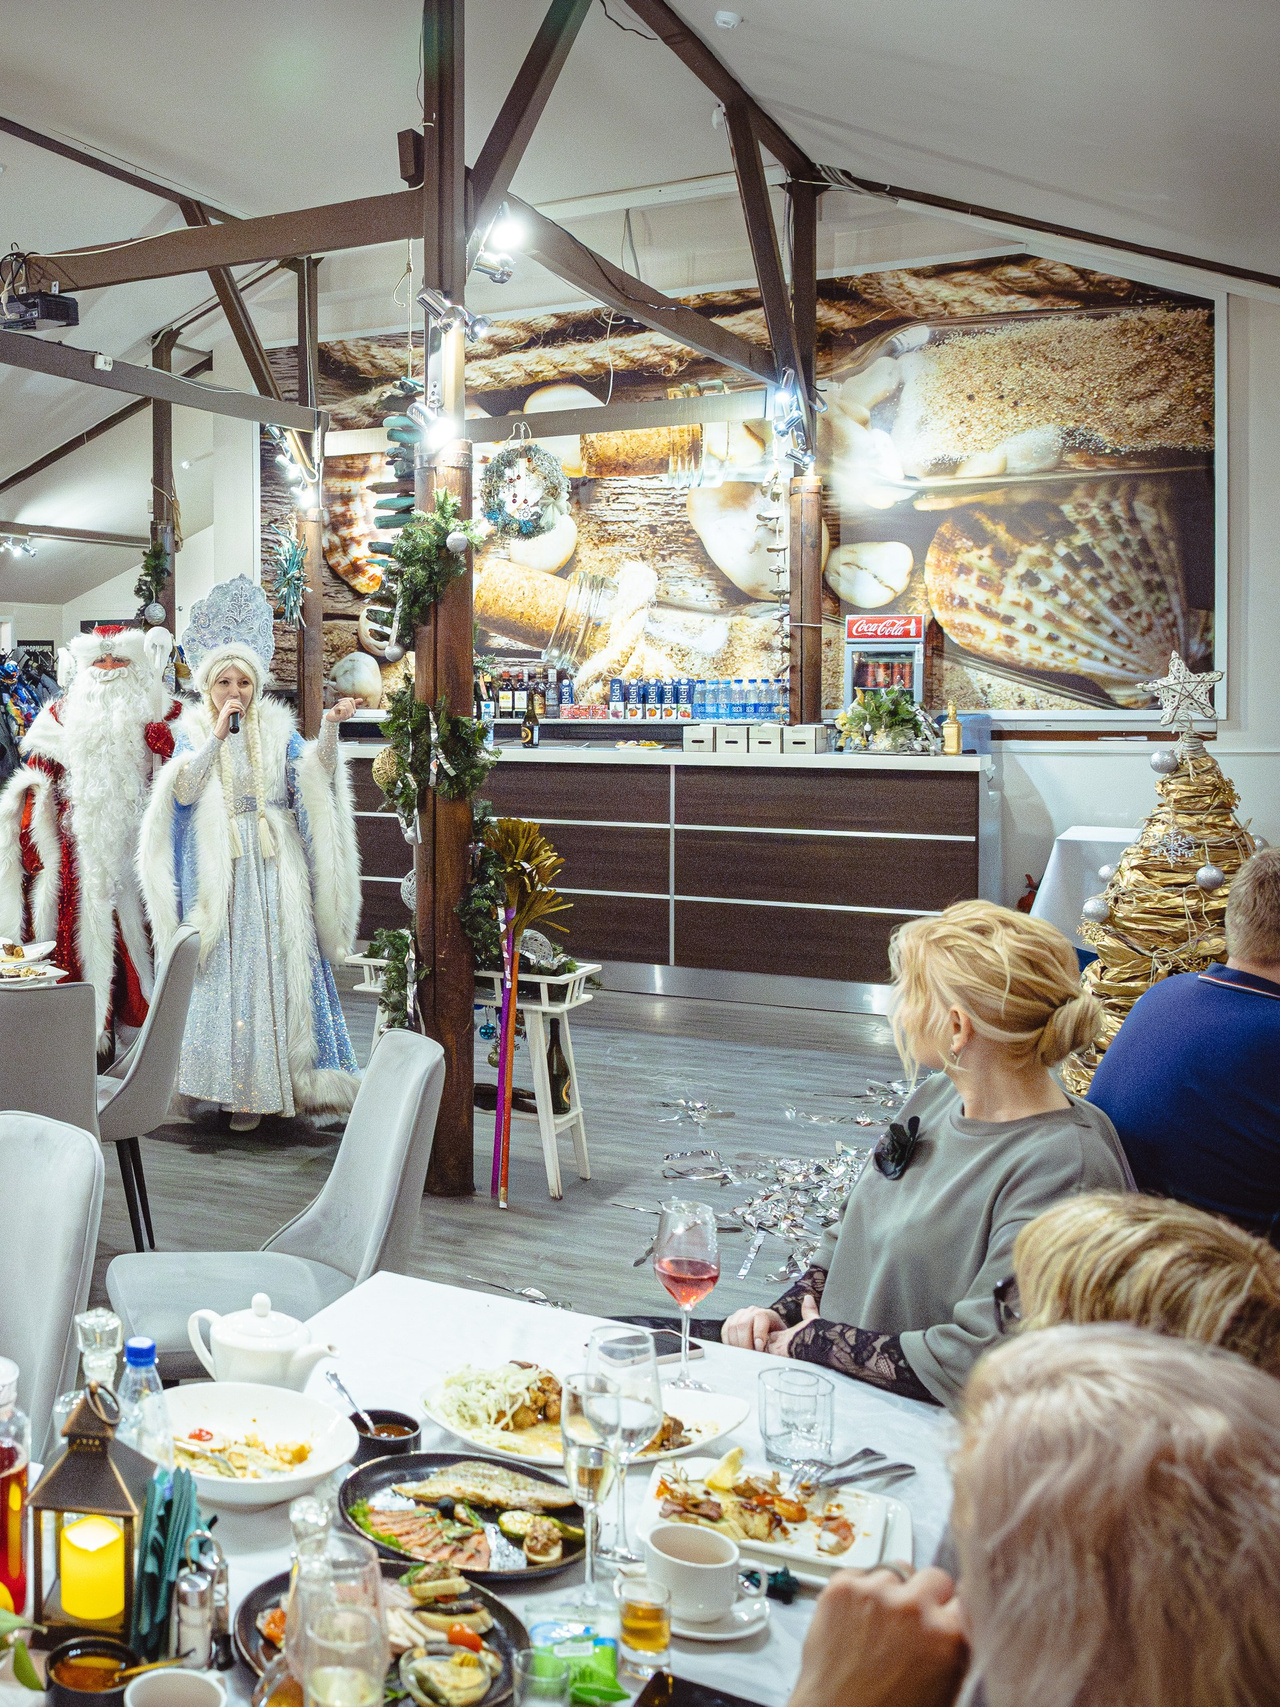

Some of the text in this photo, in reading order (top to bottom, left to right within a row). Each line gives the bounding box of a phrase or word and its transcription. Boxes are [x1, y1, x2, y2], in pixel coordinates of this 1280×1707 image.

[852, 619, 908, 636] Coca-Cola
[612, 683, 620, 701] Rich
[629, 686, 637, 704] Rich
[648, 686, 656, 704] Rich
[664, 685, 672, 704] Rich
[680, 685, 689, 704] Rich
